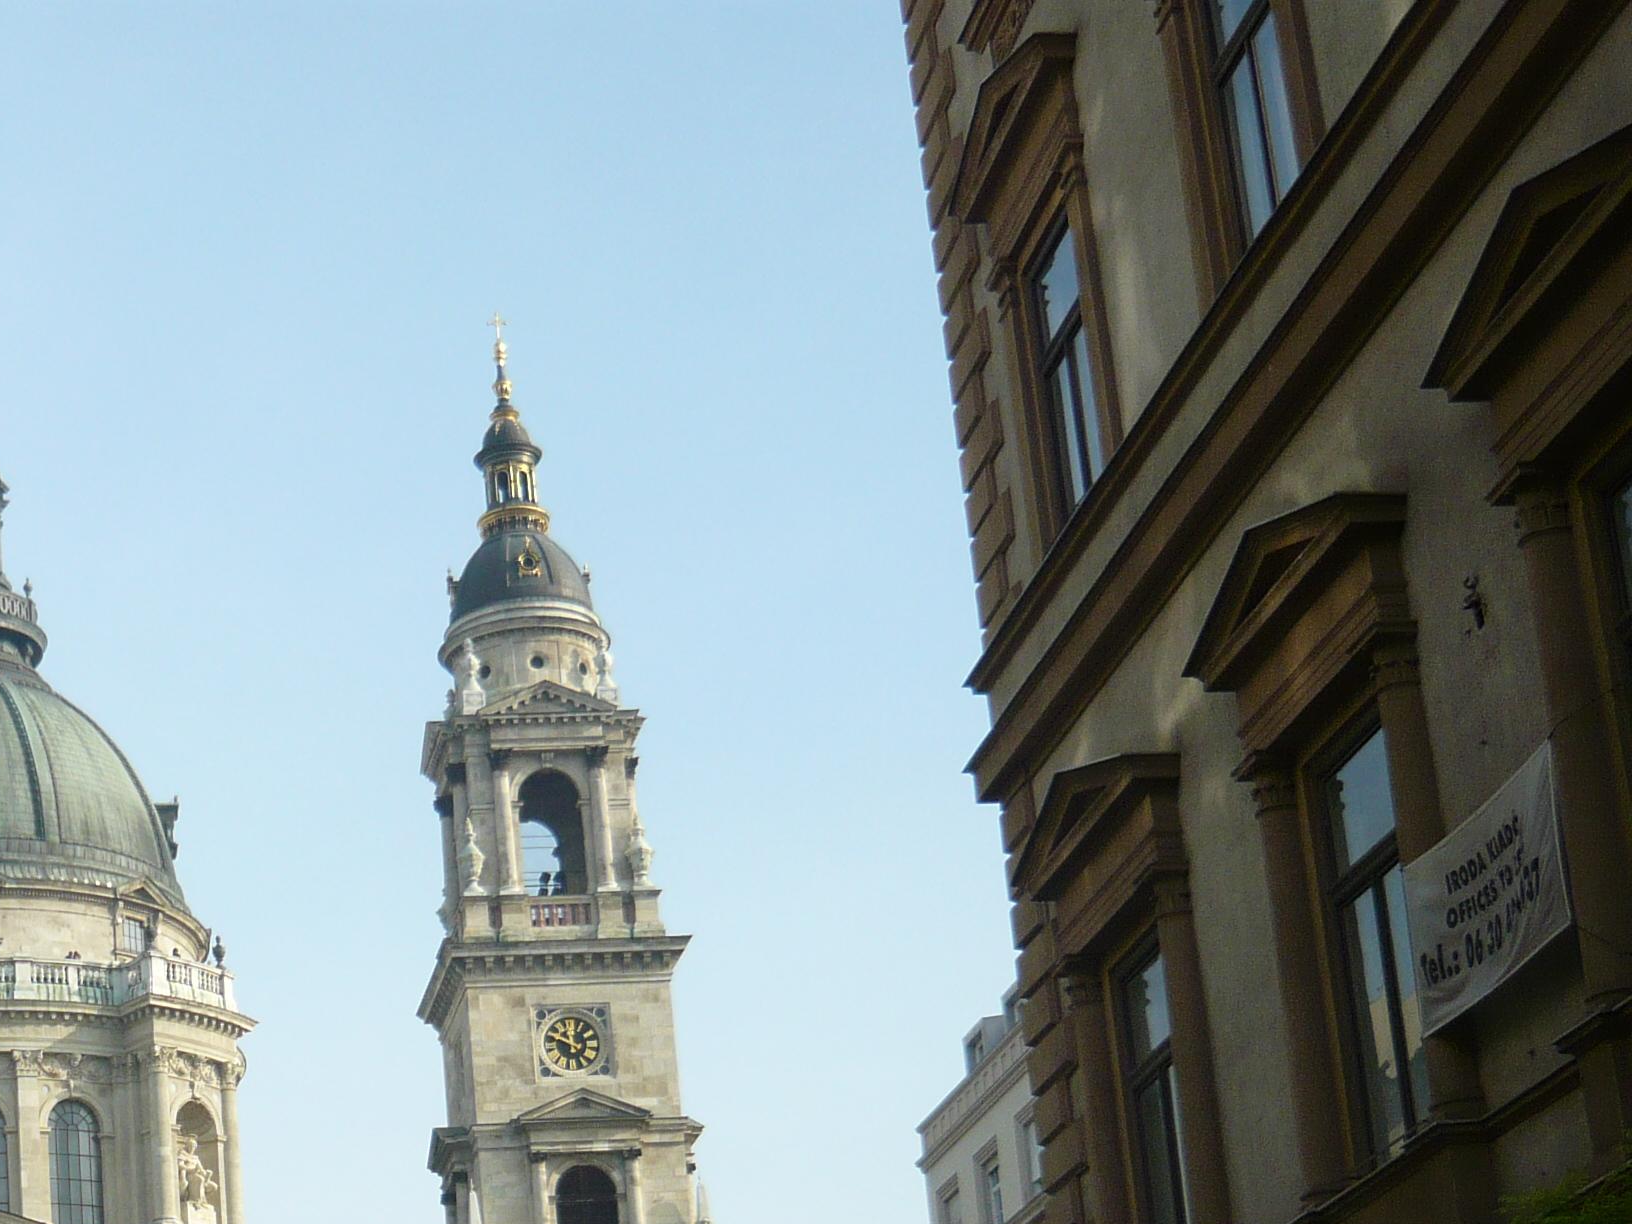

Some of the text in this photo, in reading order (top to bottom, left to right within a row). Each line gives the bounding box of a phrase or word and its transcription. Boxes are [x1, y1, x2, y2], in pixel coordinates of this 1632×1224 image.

[1445, 851, 1487, 895] IRODA
[1446, 879, 1498, 929] OFFICES
[1464, 929, 1483, 968] 06
[1489, 914, 1502, 955] 30
